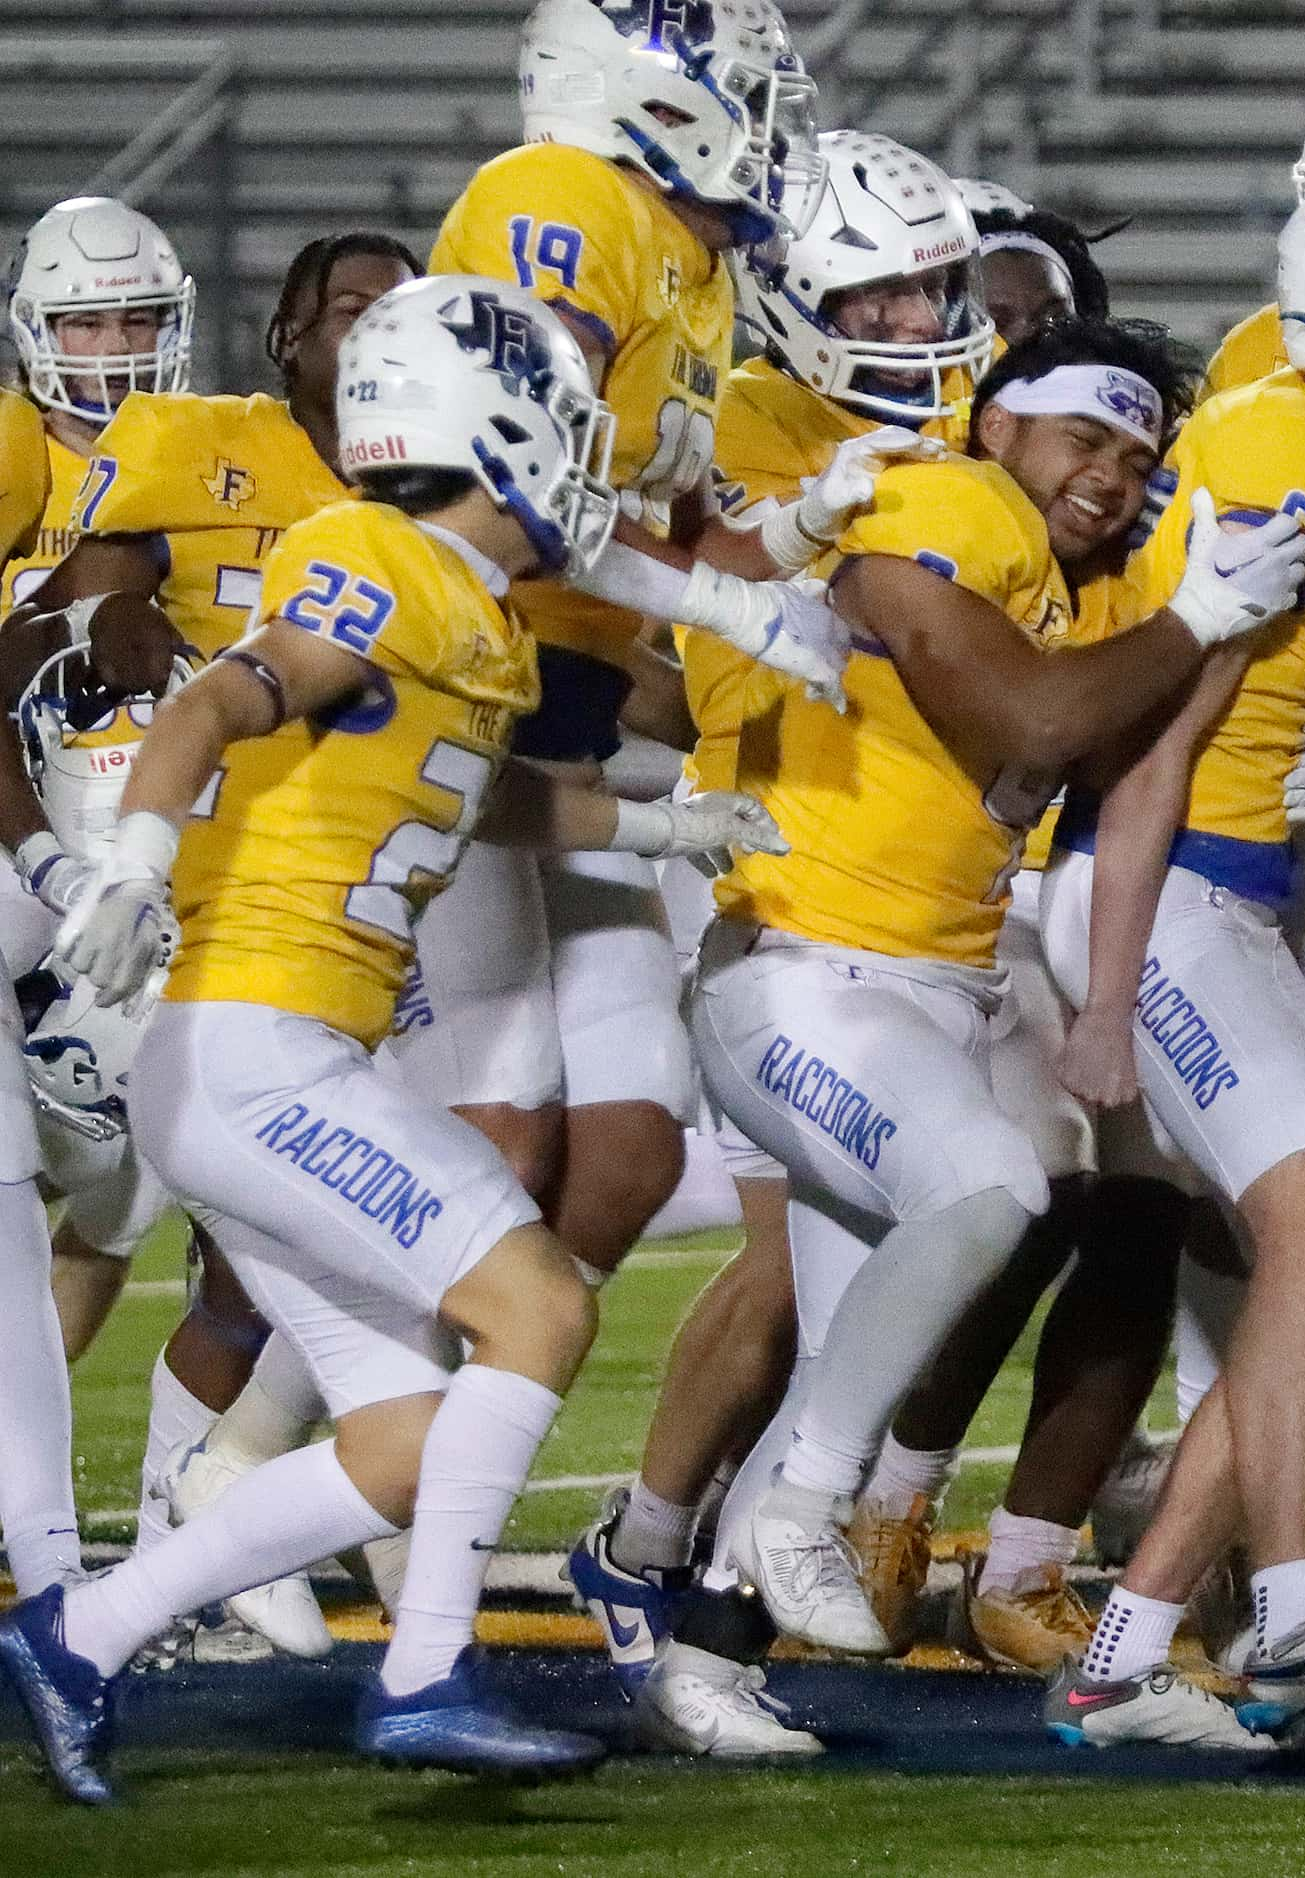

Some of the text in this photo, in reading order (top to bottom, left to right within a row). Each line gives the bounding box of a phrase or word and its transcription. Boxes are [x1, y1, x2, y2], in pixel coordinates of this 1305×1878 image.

[509, 214, 584, 289] 19
[912, 235, 968, 263] Riddell
[221, 467, 249, 501] F
[281, 560, 397, 657] 22
[756, 1033, 898, 1171] RACCOONS
[255, 1102, 444, 1250] RACCOONS
